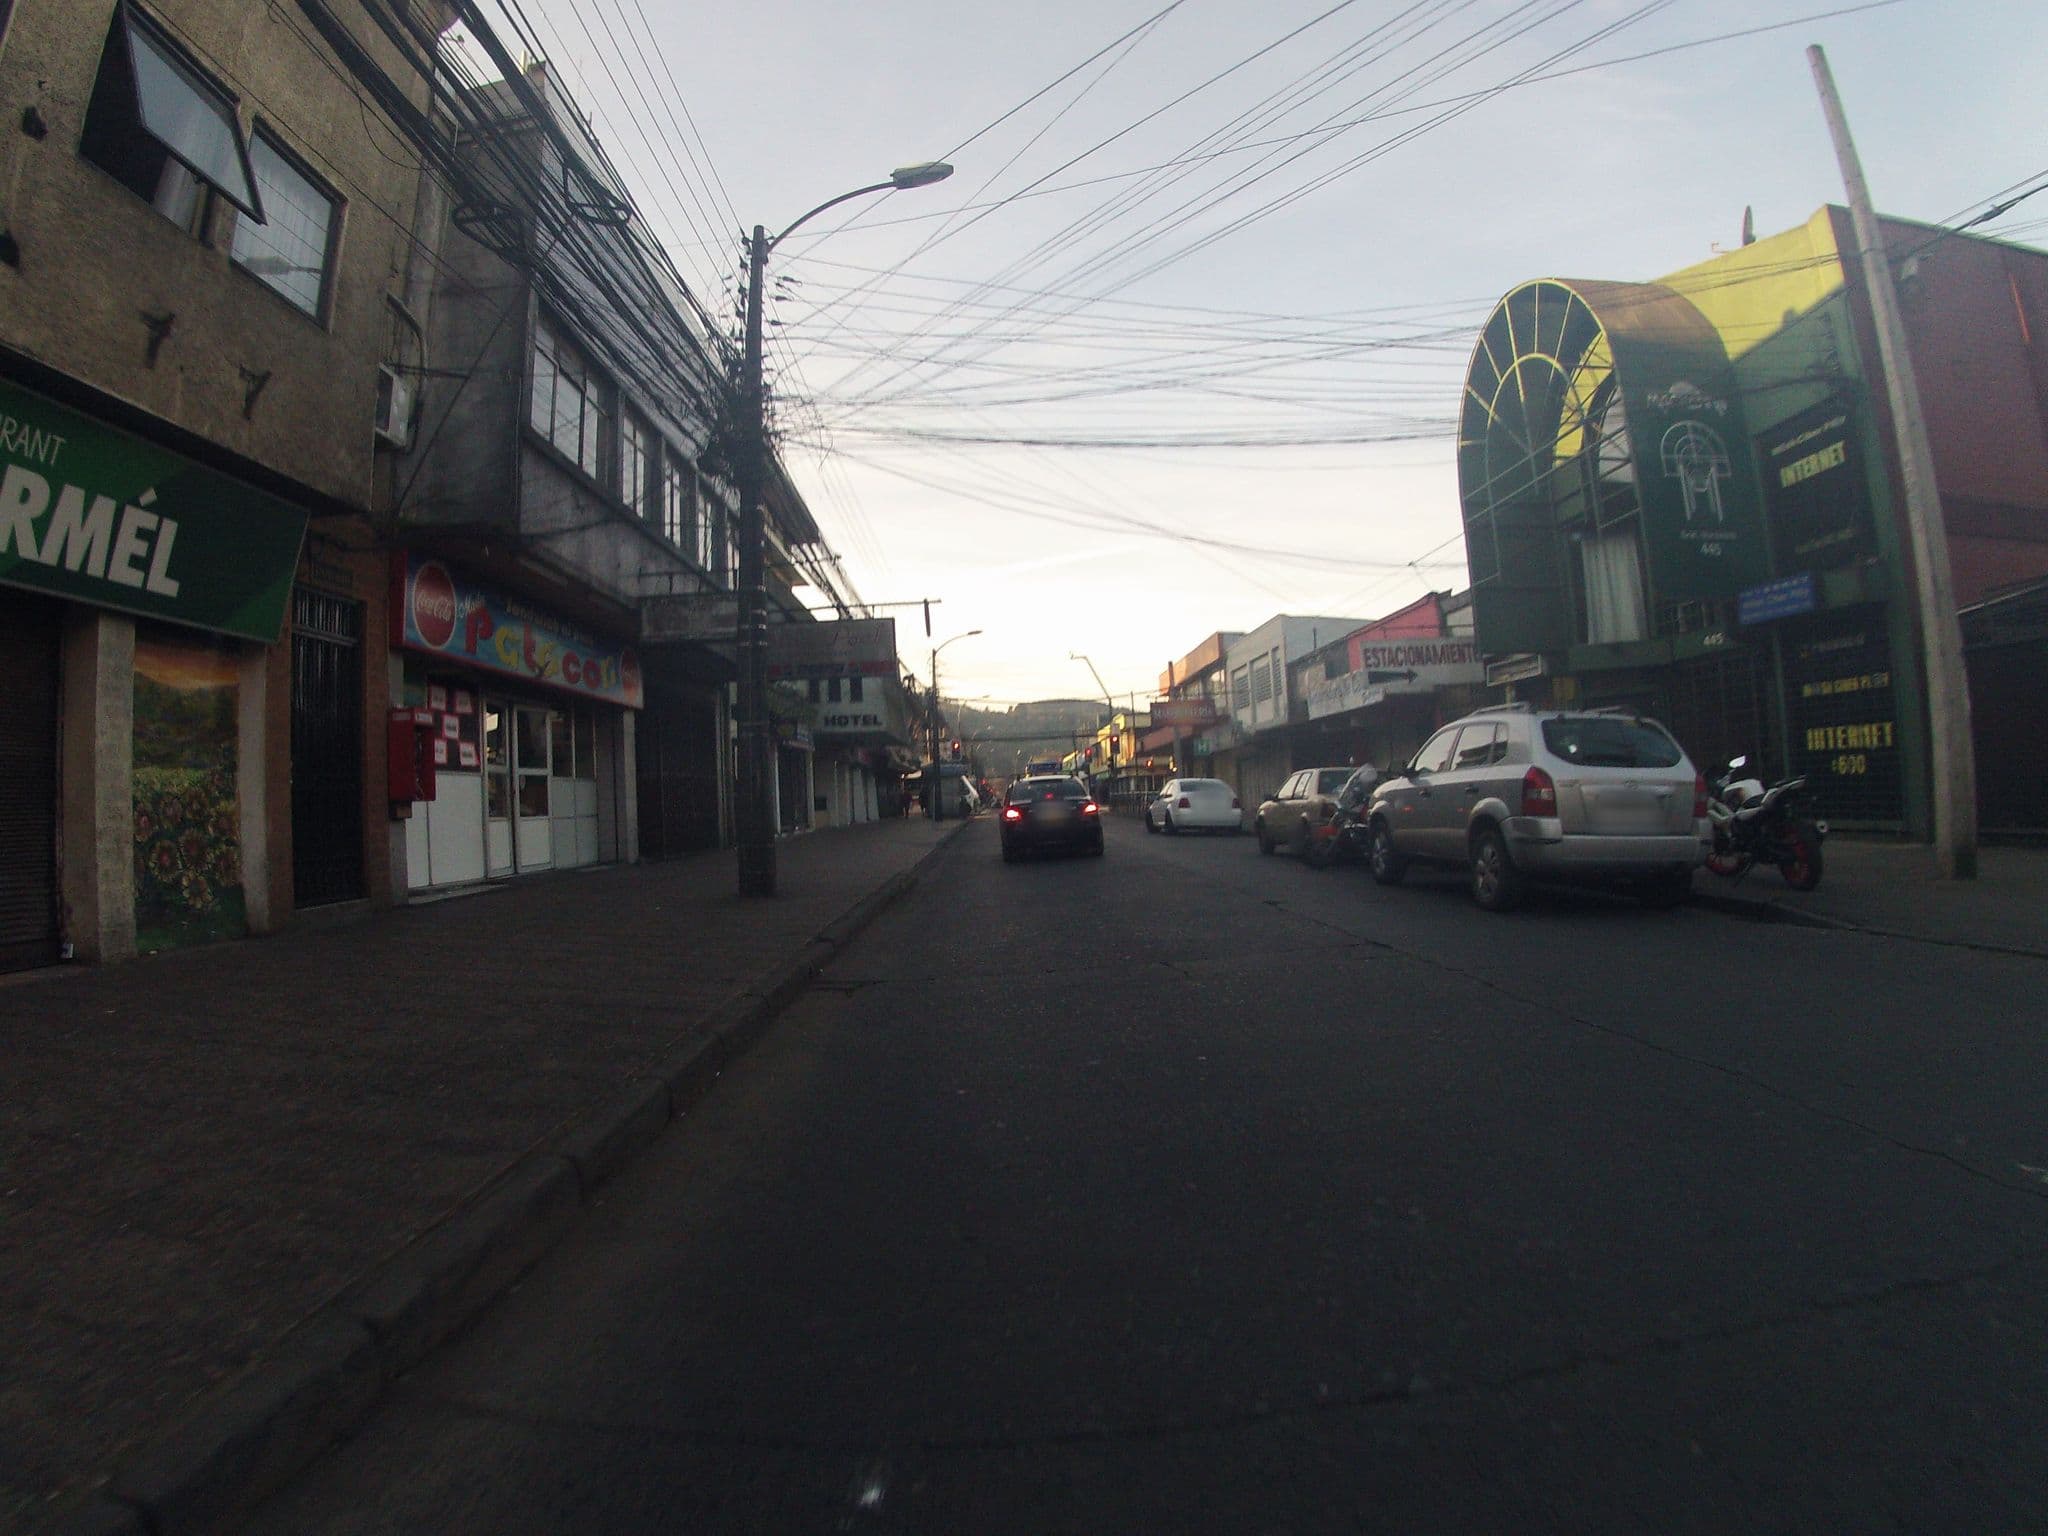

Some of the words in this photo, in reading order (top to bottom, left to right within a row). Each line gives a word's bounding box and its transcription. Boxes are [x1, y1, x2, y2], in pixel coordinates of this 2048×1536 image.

[0, 413, 66, 466] RANT
[823, 713, 883, 728] HOTEL
[1806, 721, 1894, 751] INTERNET
